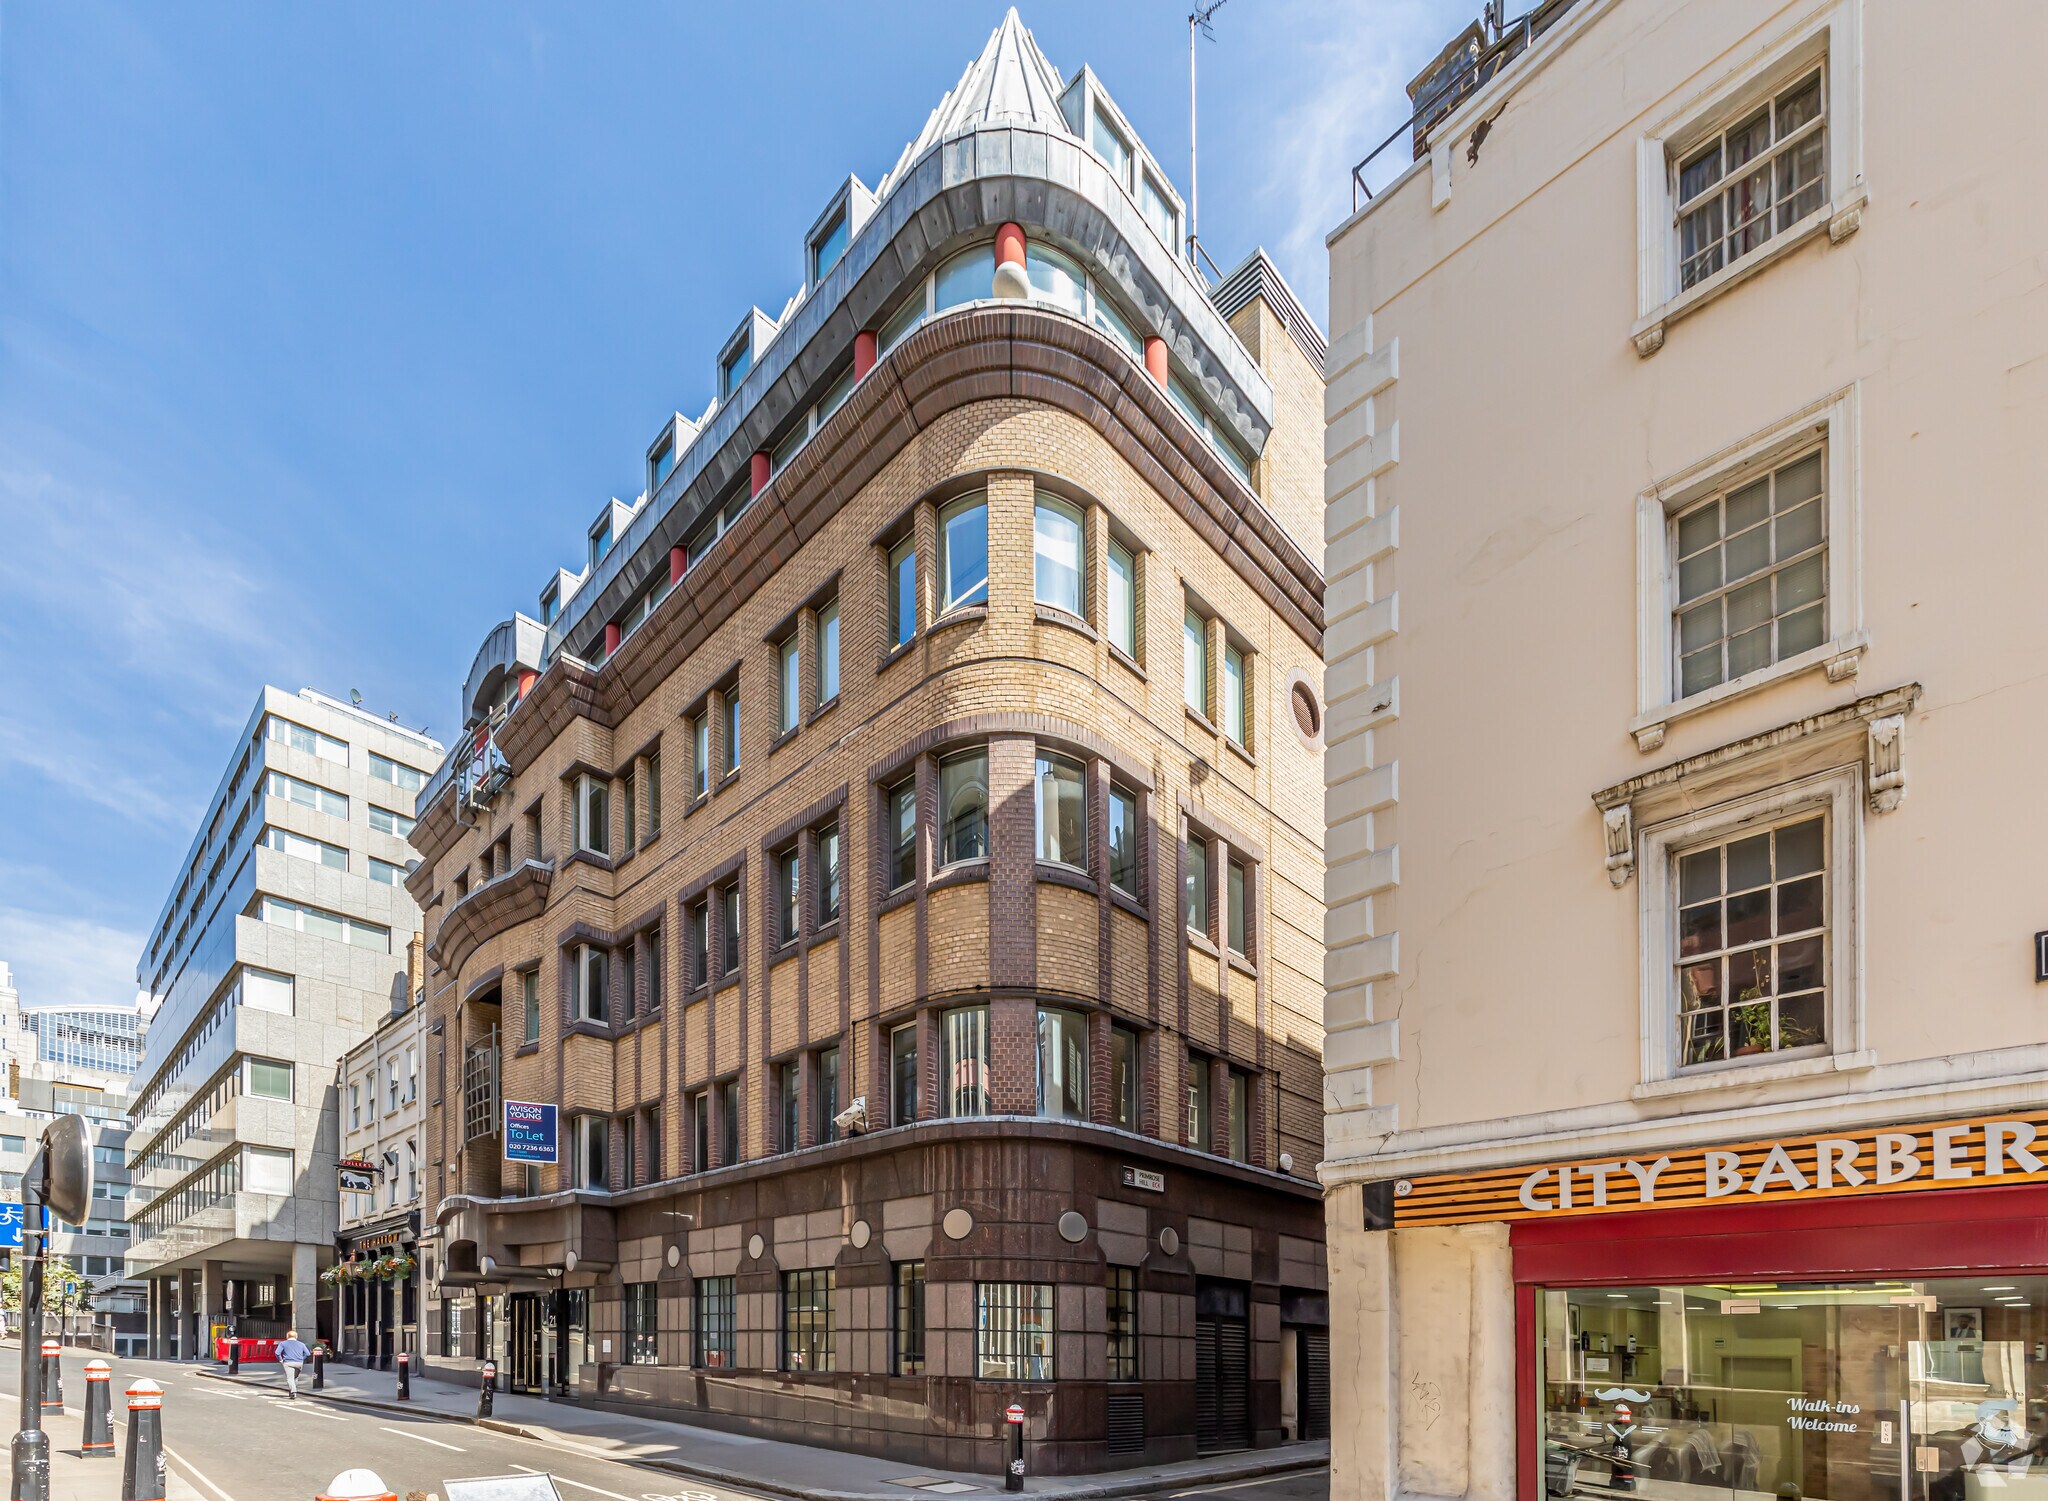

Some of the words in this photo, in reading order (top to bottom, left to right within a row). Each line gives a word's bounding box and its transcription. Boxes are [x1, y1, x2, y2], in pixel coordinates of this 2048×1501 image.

[509, 1105, 542, 1114] AVISON
[509, 1111, 542, 1120] YOUNG
[509, 1128, 523, 1139] To
[526, 1130, 544, 1141] Let
[1518, 1155, 1672, 1211] CITY
[1704, 1121, 2046, 1198] BARBER
[1398, 1184, 1408, 1192] 24
[359, 1239, 371, 1249] THE
[549, 1315, 557, 1326] 21
[1786, 1397, 1861, 1414] Walk-ins
[1786, 1416, 1858, 1433] Welcome
